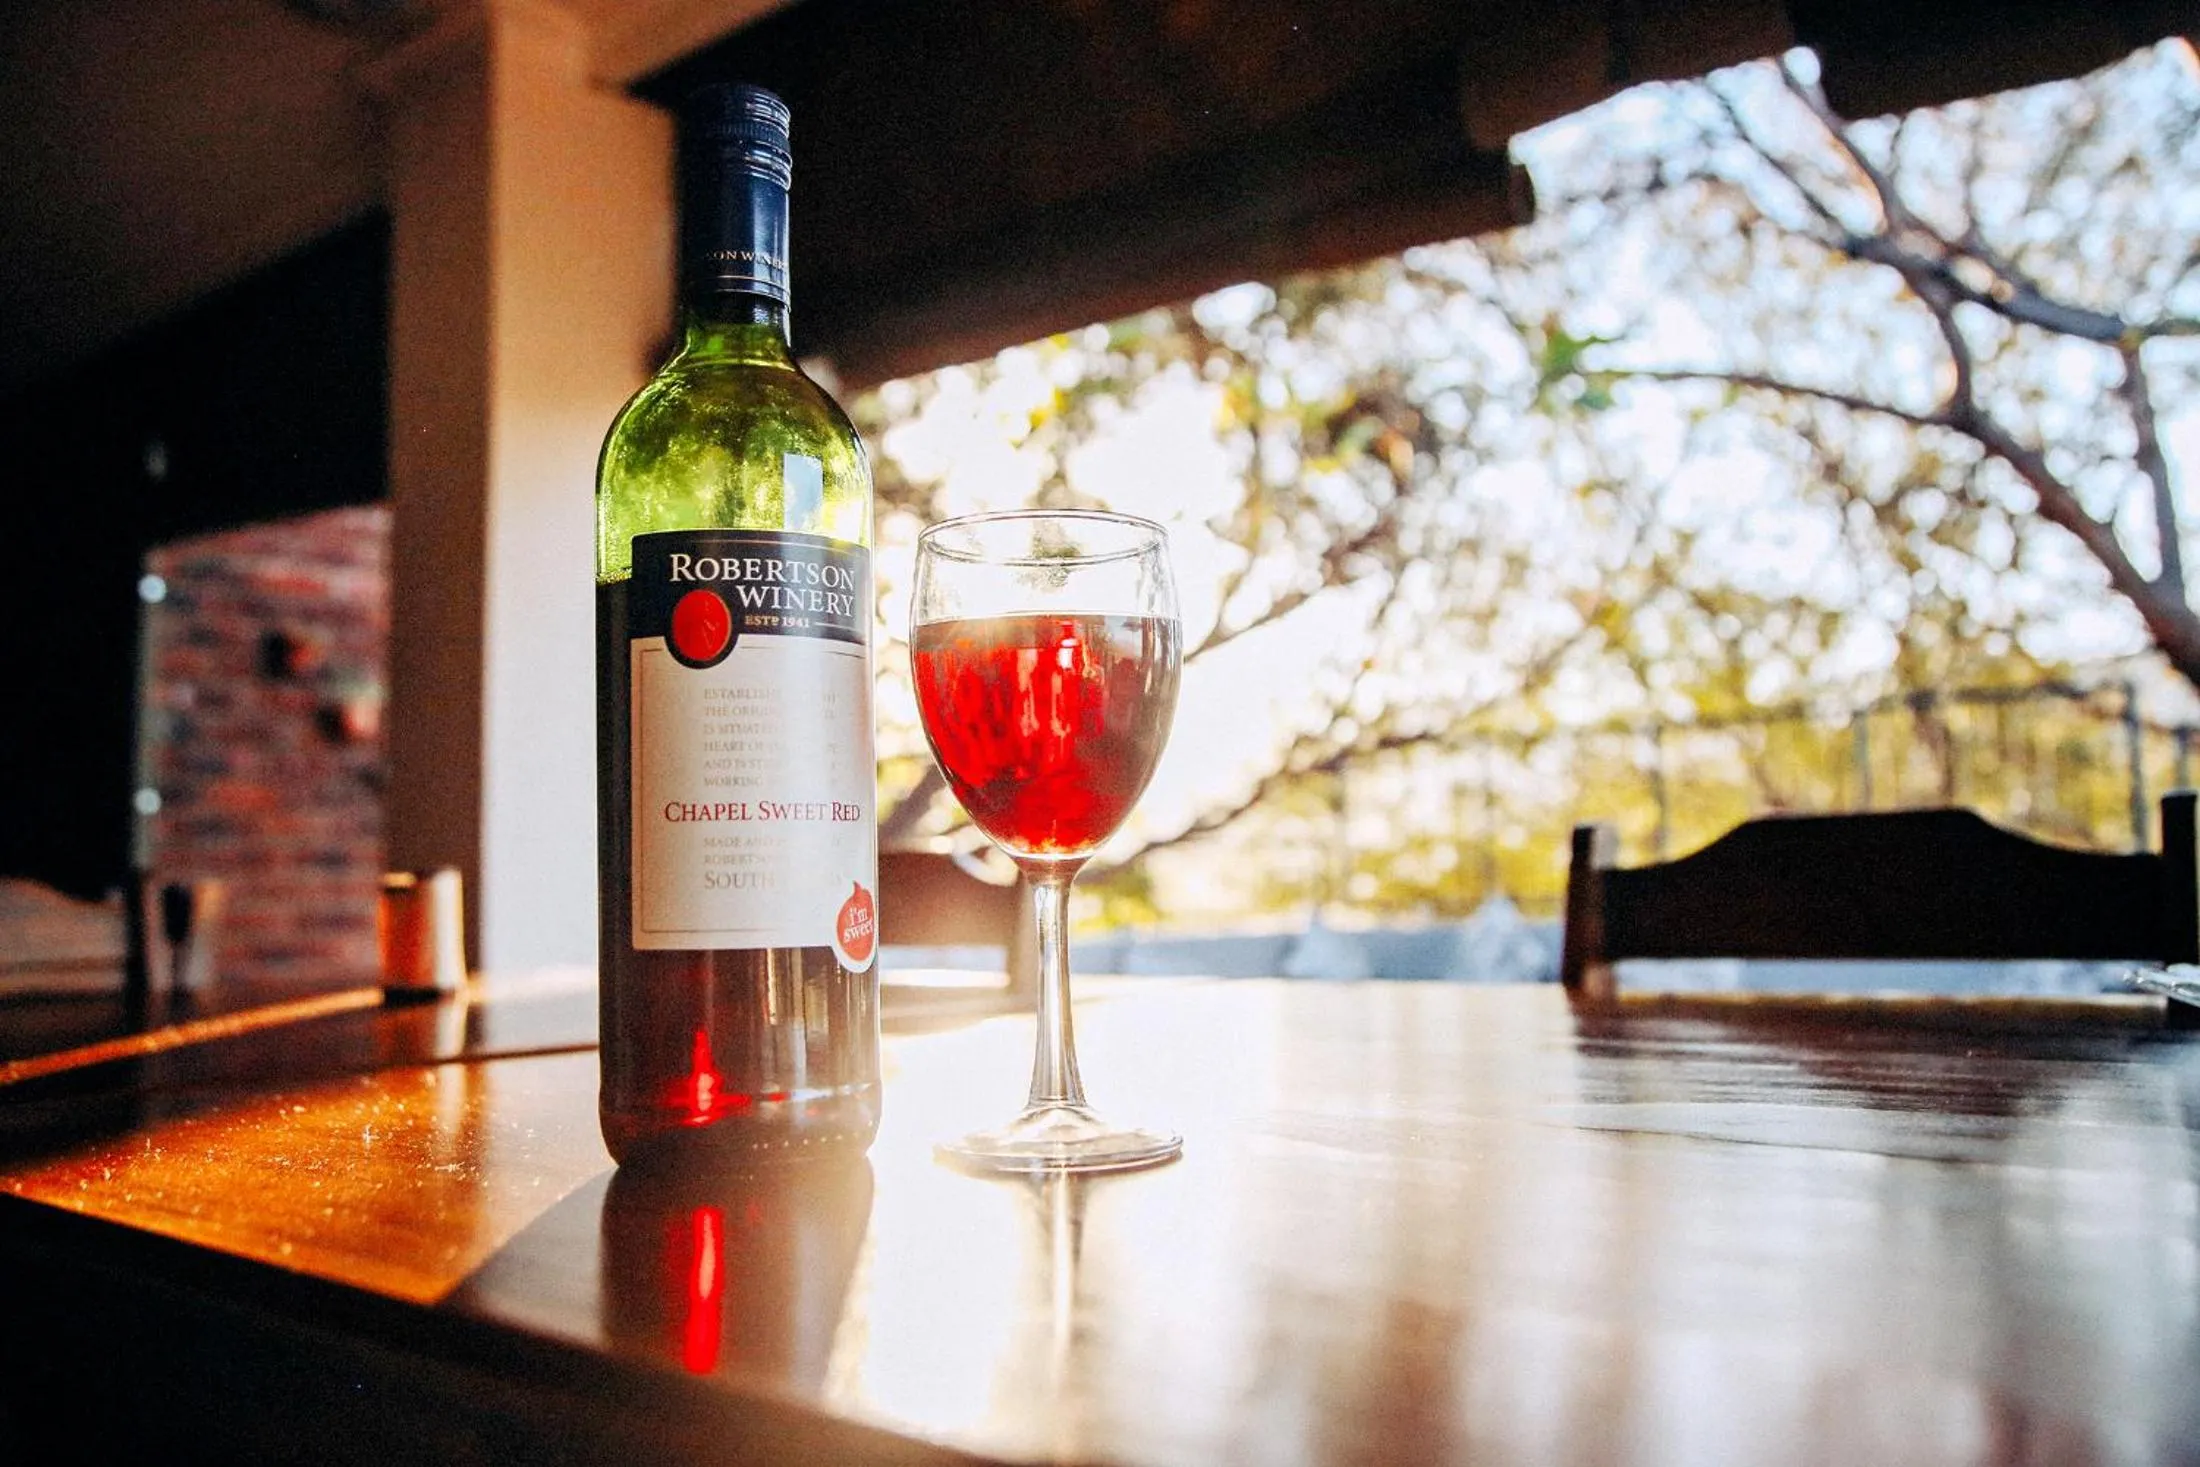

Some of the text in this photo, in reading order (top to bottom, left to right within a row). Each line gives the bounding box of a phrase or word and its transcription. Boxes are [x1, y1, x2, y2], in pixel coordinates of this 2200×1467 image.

[669, 553, 855, 590] ROBERTSON
[736, 585, 855, 617] WINERY
[782, 616, 810, 628] 1941
[704, 705, 729, 717] THE
[704, 741, 745, 752] HEART
[704, 776, 764, 787] WORKING
[665, 800, 861, 823] CHAPEL SWEET RED
[704, 837, 740, 848] MADE
[704, 870, 775, 890] SOUTH
[849, 908, 868, 927] i'm
[844, 921, 874, 943] sweet
